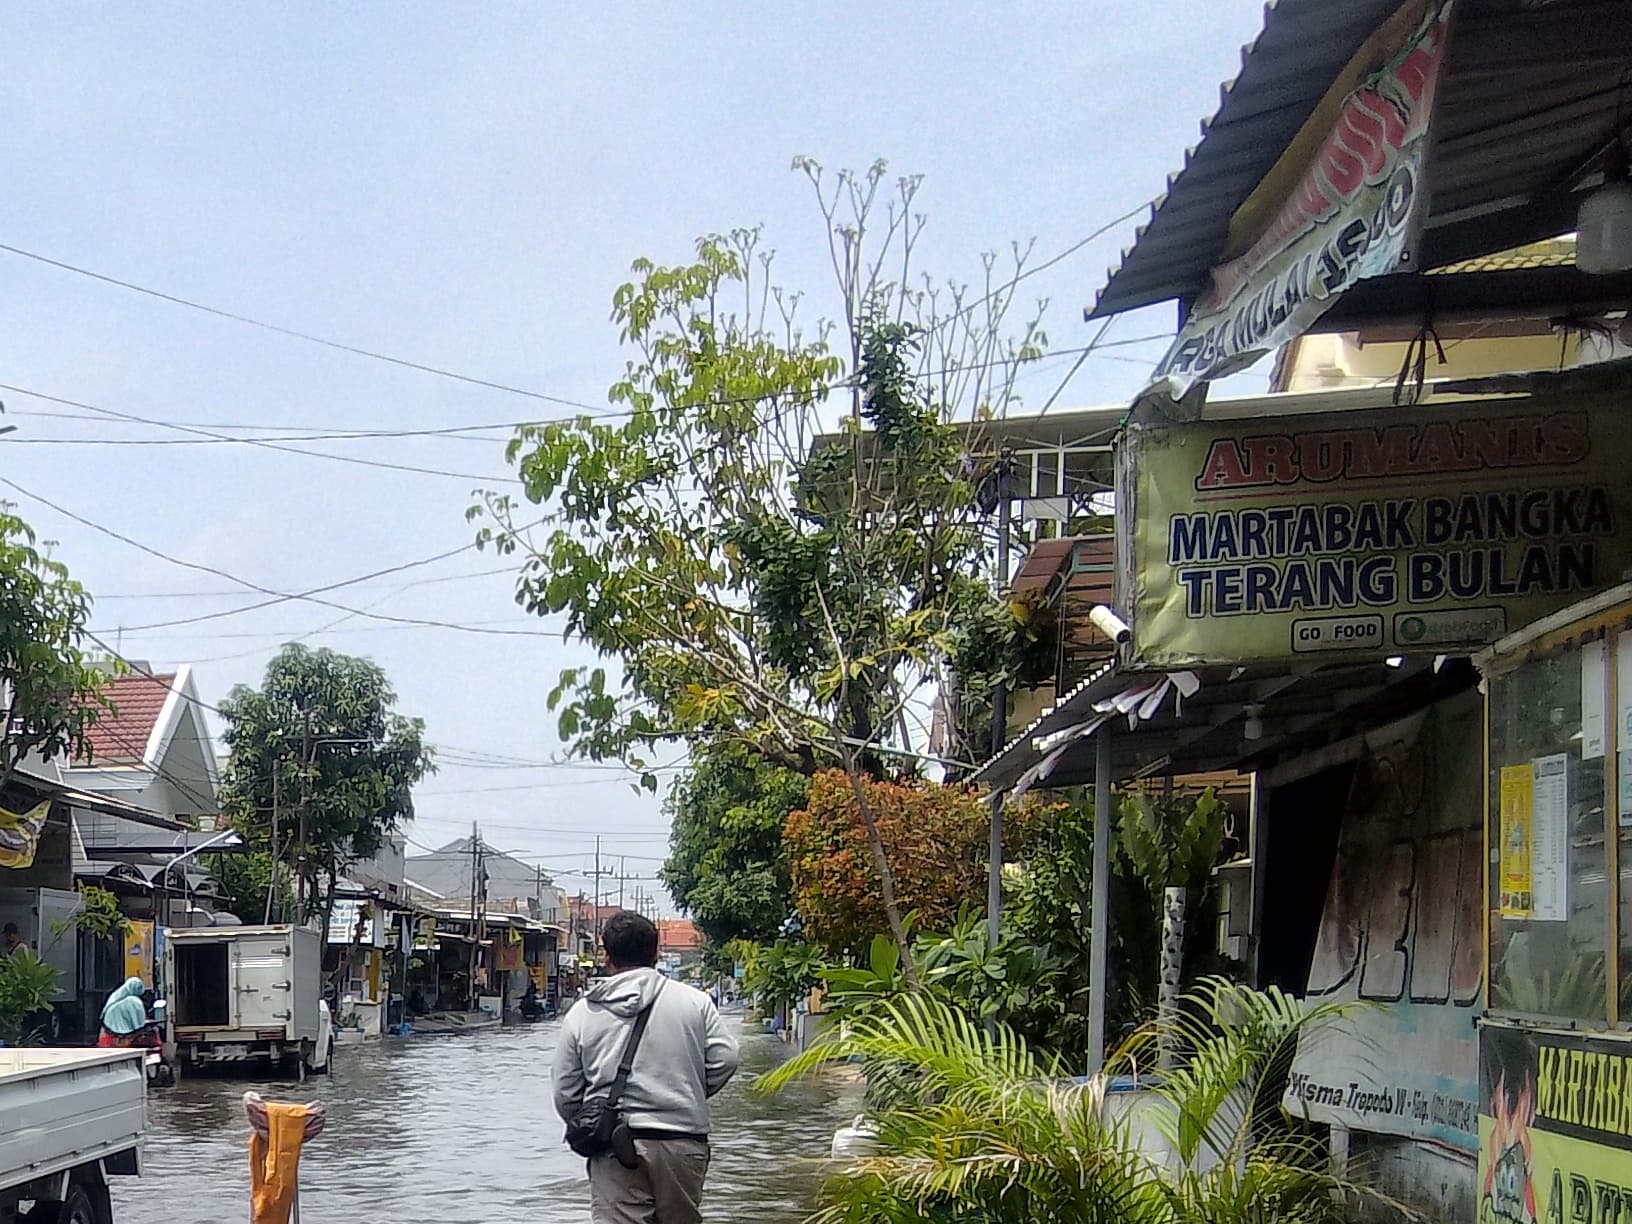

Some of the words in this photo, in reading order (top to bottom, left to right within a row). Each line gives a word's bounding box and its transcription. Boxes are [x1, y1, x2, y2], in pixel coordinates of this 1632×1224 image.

[1232, 253, 1313, 353] MULAI
[1195, 413, 1591, 491] ARUMANIS
[1170, 500, 1416, 565] MARTABAK
[1425, 487, 1614, 546] BANGKA
[1180, 556, 1398, 618] TERANG
[1409, 543, 1596, 601] BULAN
[1299, 624, 1321, 641] GO
[1334, 621, 1377, 639] FOOD
